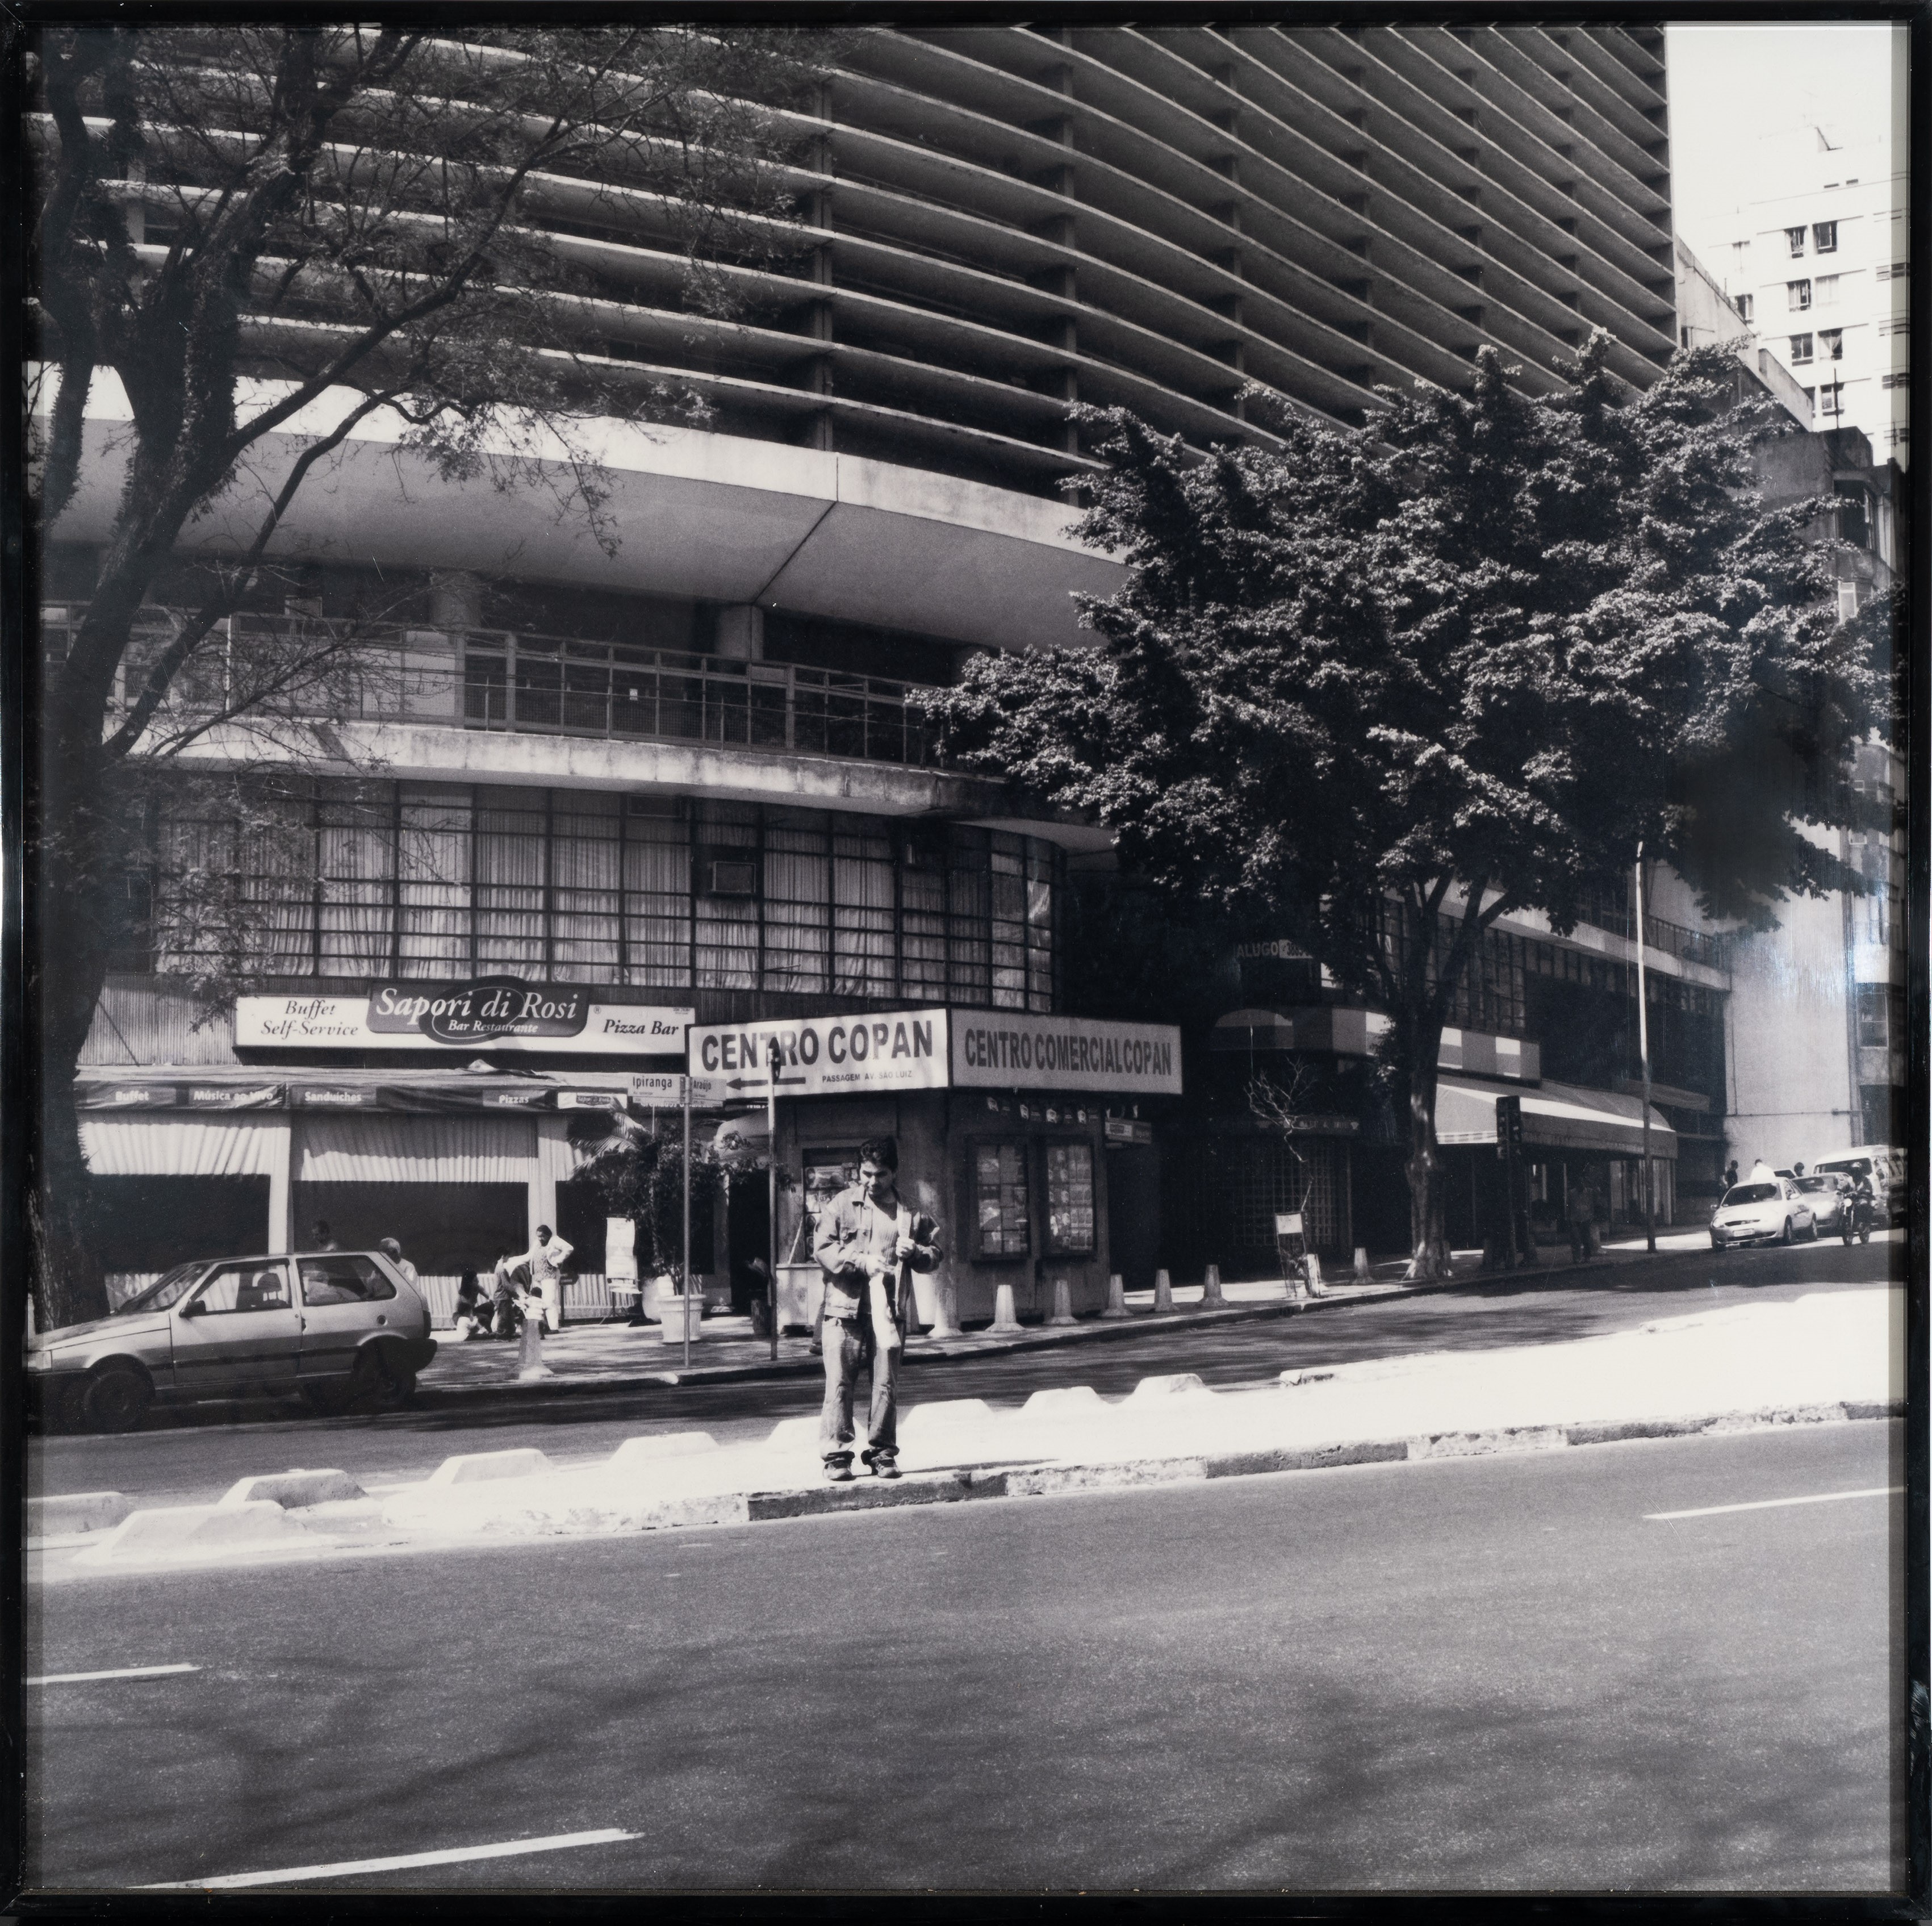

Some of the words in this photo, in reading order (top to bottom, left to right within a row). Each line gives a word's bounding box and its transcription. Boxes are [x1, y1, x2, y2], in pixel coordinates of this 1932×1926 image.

[1237, 941, 1278, 958] ALUGO
[285, 998, 336, 1020] Buffet
[376, 987, 473, 1025] Sapori
[480, 989, 511, 1017] di
[518, 992, 578, 1020] Rosi
[260, 1020, 358, 1039] Self-Service
[448, 1020, 470, 1031] Bar
[472, 1020, 540, 1033] Restaurante
[603, 1019, 645, 1034] Pizza
[650, 1021, 679, 1035] Bar
[701, 1027, 819, 1072] CENTRO
[828, 1020, 932, 1064] COPAN
[965, 1028, 1032, 1069] CENTRO
[1035, 1033, 1123, 1074] COMERCIAL
[1123, 1038, 1172, 1076] COPAN
[633, 1076, 672, 1090] Ipiranga
[822, 1073, 860, 1083] PASSAGEM
[115, 1090, 149, 1101] Buffet
[194, 1089, 231, 1101] Música
[499, 1094, 529, 1104] Pizzas
